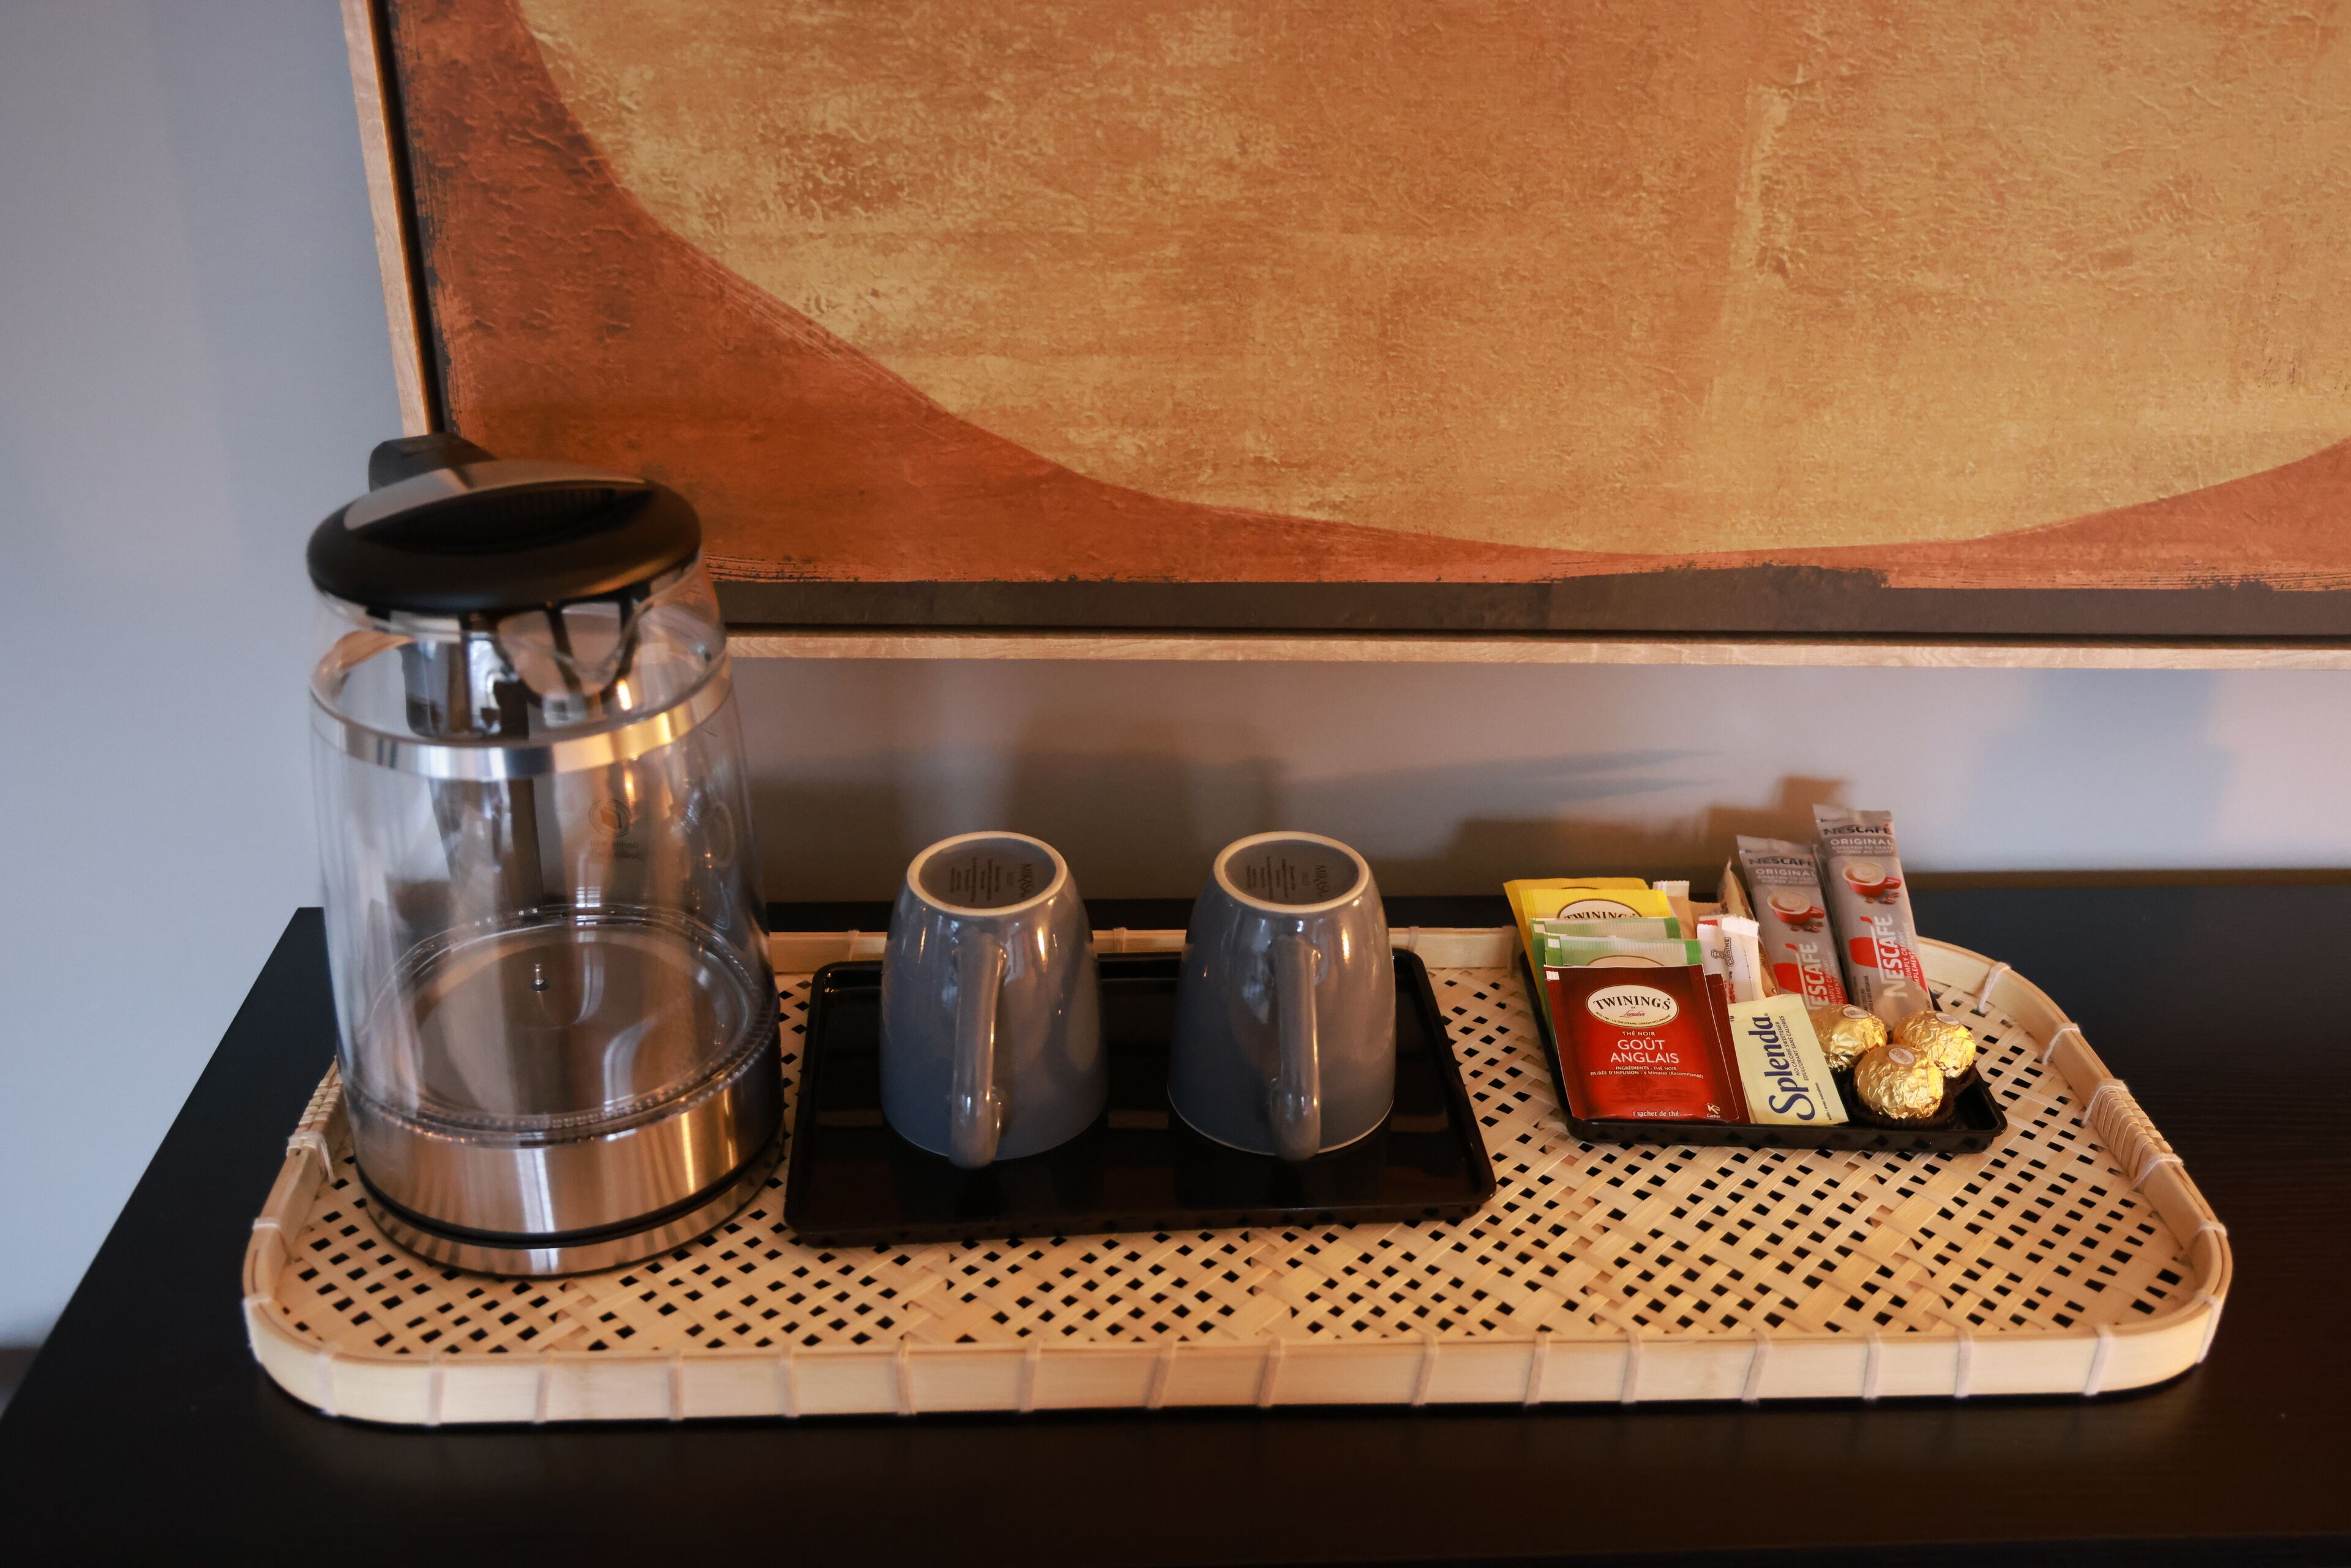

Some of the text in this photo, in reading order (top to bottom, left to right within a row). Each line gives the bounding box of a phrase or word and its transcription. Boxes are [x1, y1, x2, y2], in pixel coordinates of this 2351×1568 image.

[1755, 869, 1818, 878] ORIGINAL
[1724, 937, 1734, 966] CUISINE
[1860, 913, 1908, 997] NESCAFÉ
[1784, 942, 1829, 1010] ESCAFÉ
[1902, 957, 1913, 980] SIMPLY
[1593, 996, 1671, 1010] TWININGS
[1779, 1015, 1793, 1038] CALORIES
[1617, 1037, 1665, 1050] GOÛT
[1775, 1021, 1800, 1076] NO CALORIE SWEETENER
[1610, 1052, 1679, 1063] ANGLAIS
[1793, 1049, 1809, 1081] ÉDULCORANT
